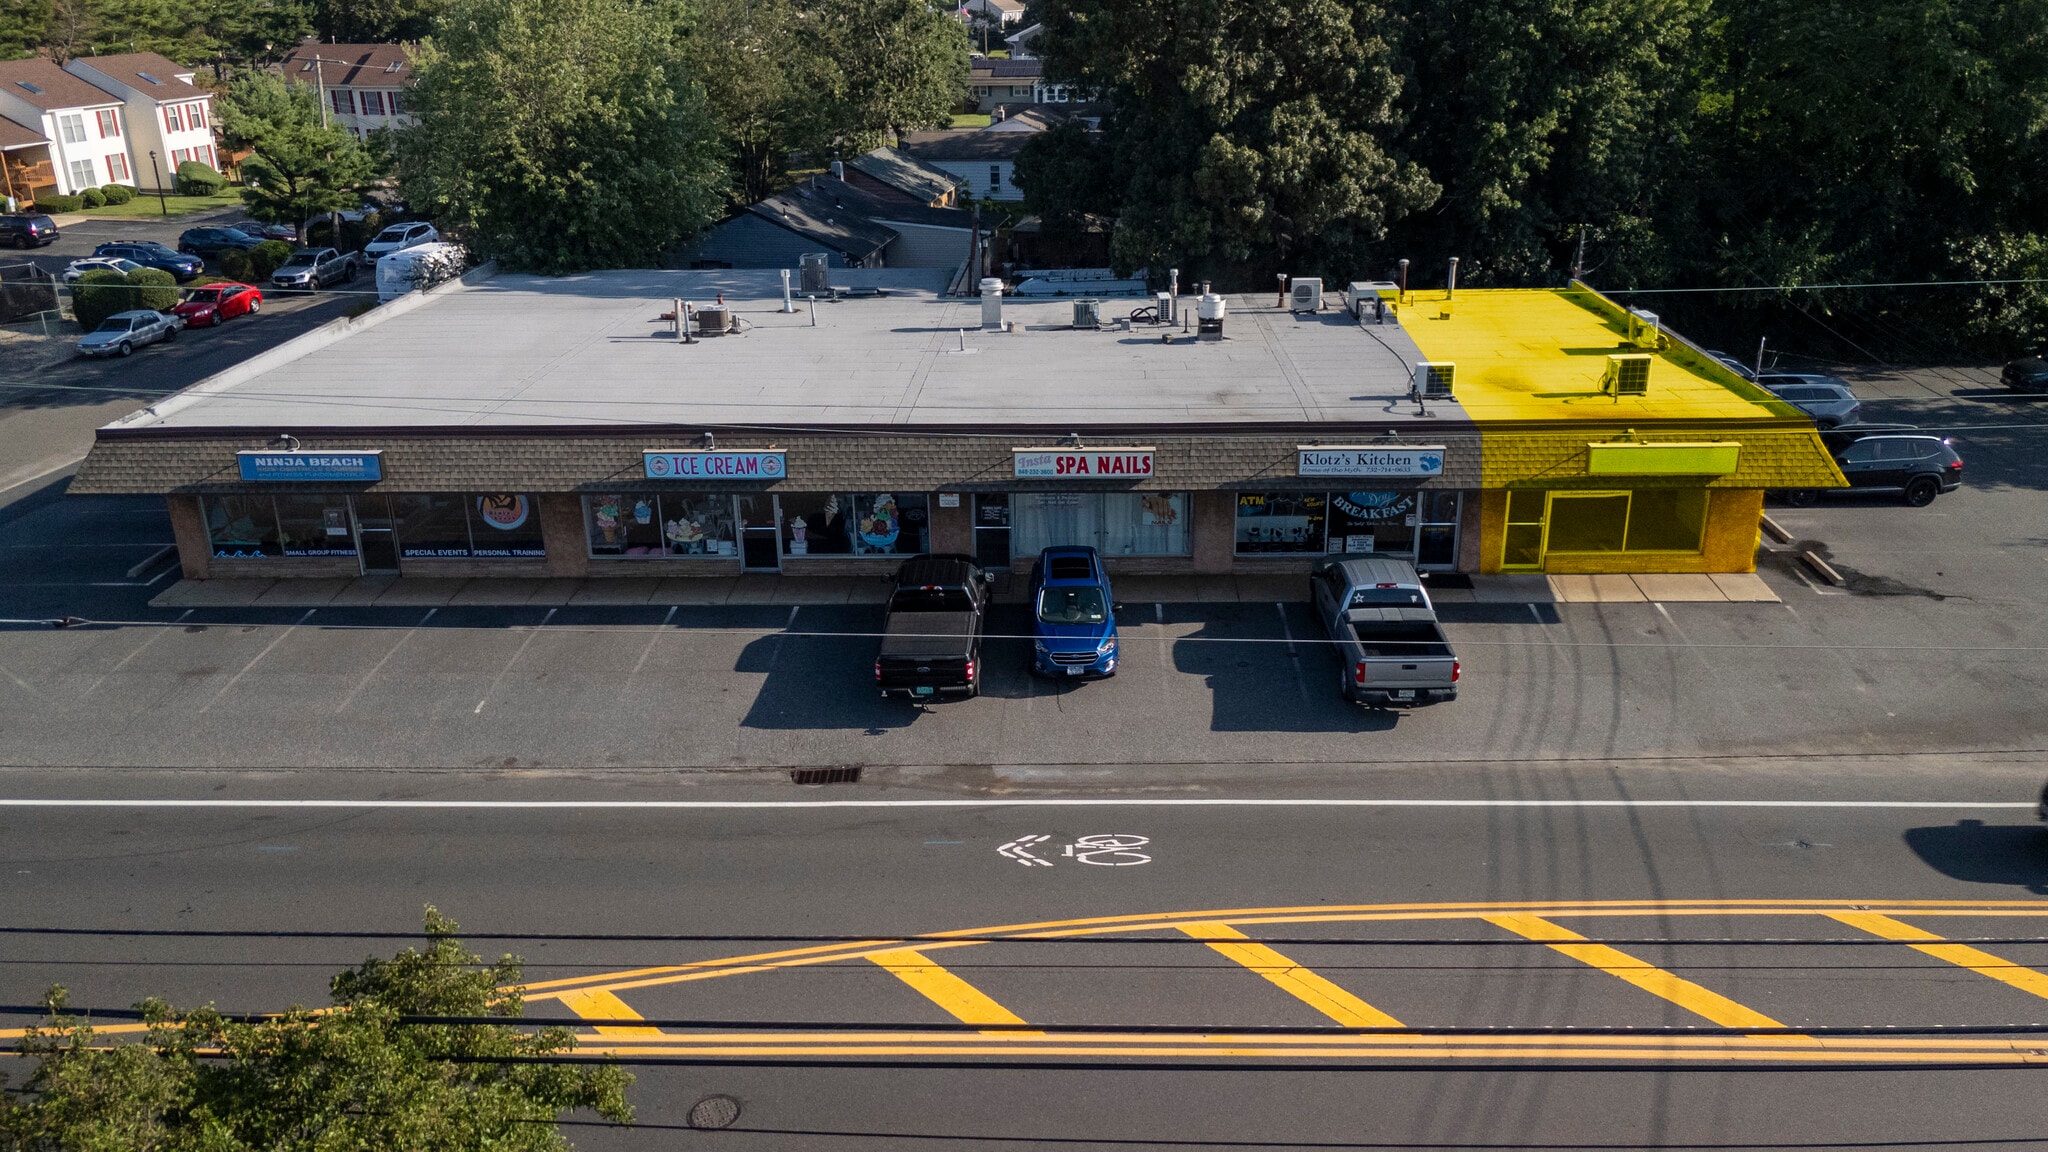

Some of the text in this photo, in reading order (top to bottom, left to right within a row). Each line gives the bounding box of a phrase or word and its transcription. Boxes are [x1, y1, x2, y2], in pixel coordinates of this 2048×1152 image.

[255, 458, 364, 466] NINJA BEACH
[673, 457, 699, 475] ICE
[705, 457, 758, 475] CREAM
[1018, 454, 1052, 468] Insta
[1056, 455, 1151, 474] SPA NAILS
[1303, 453, 1411, 465] Klotz's Kitchen
[1239, 496, 1265, 505] ATM
[1332, 495, 1414, 519] BREAKFAST
